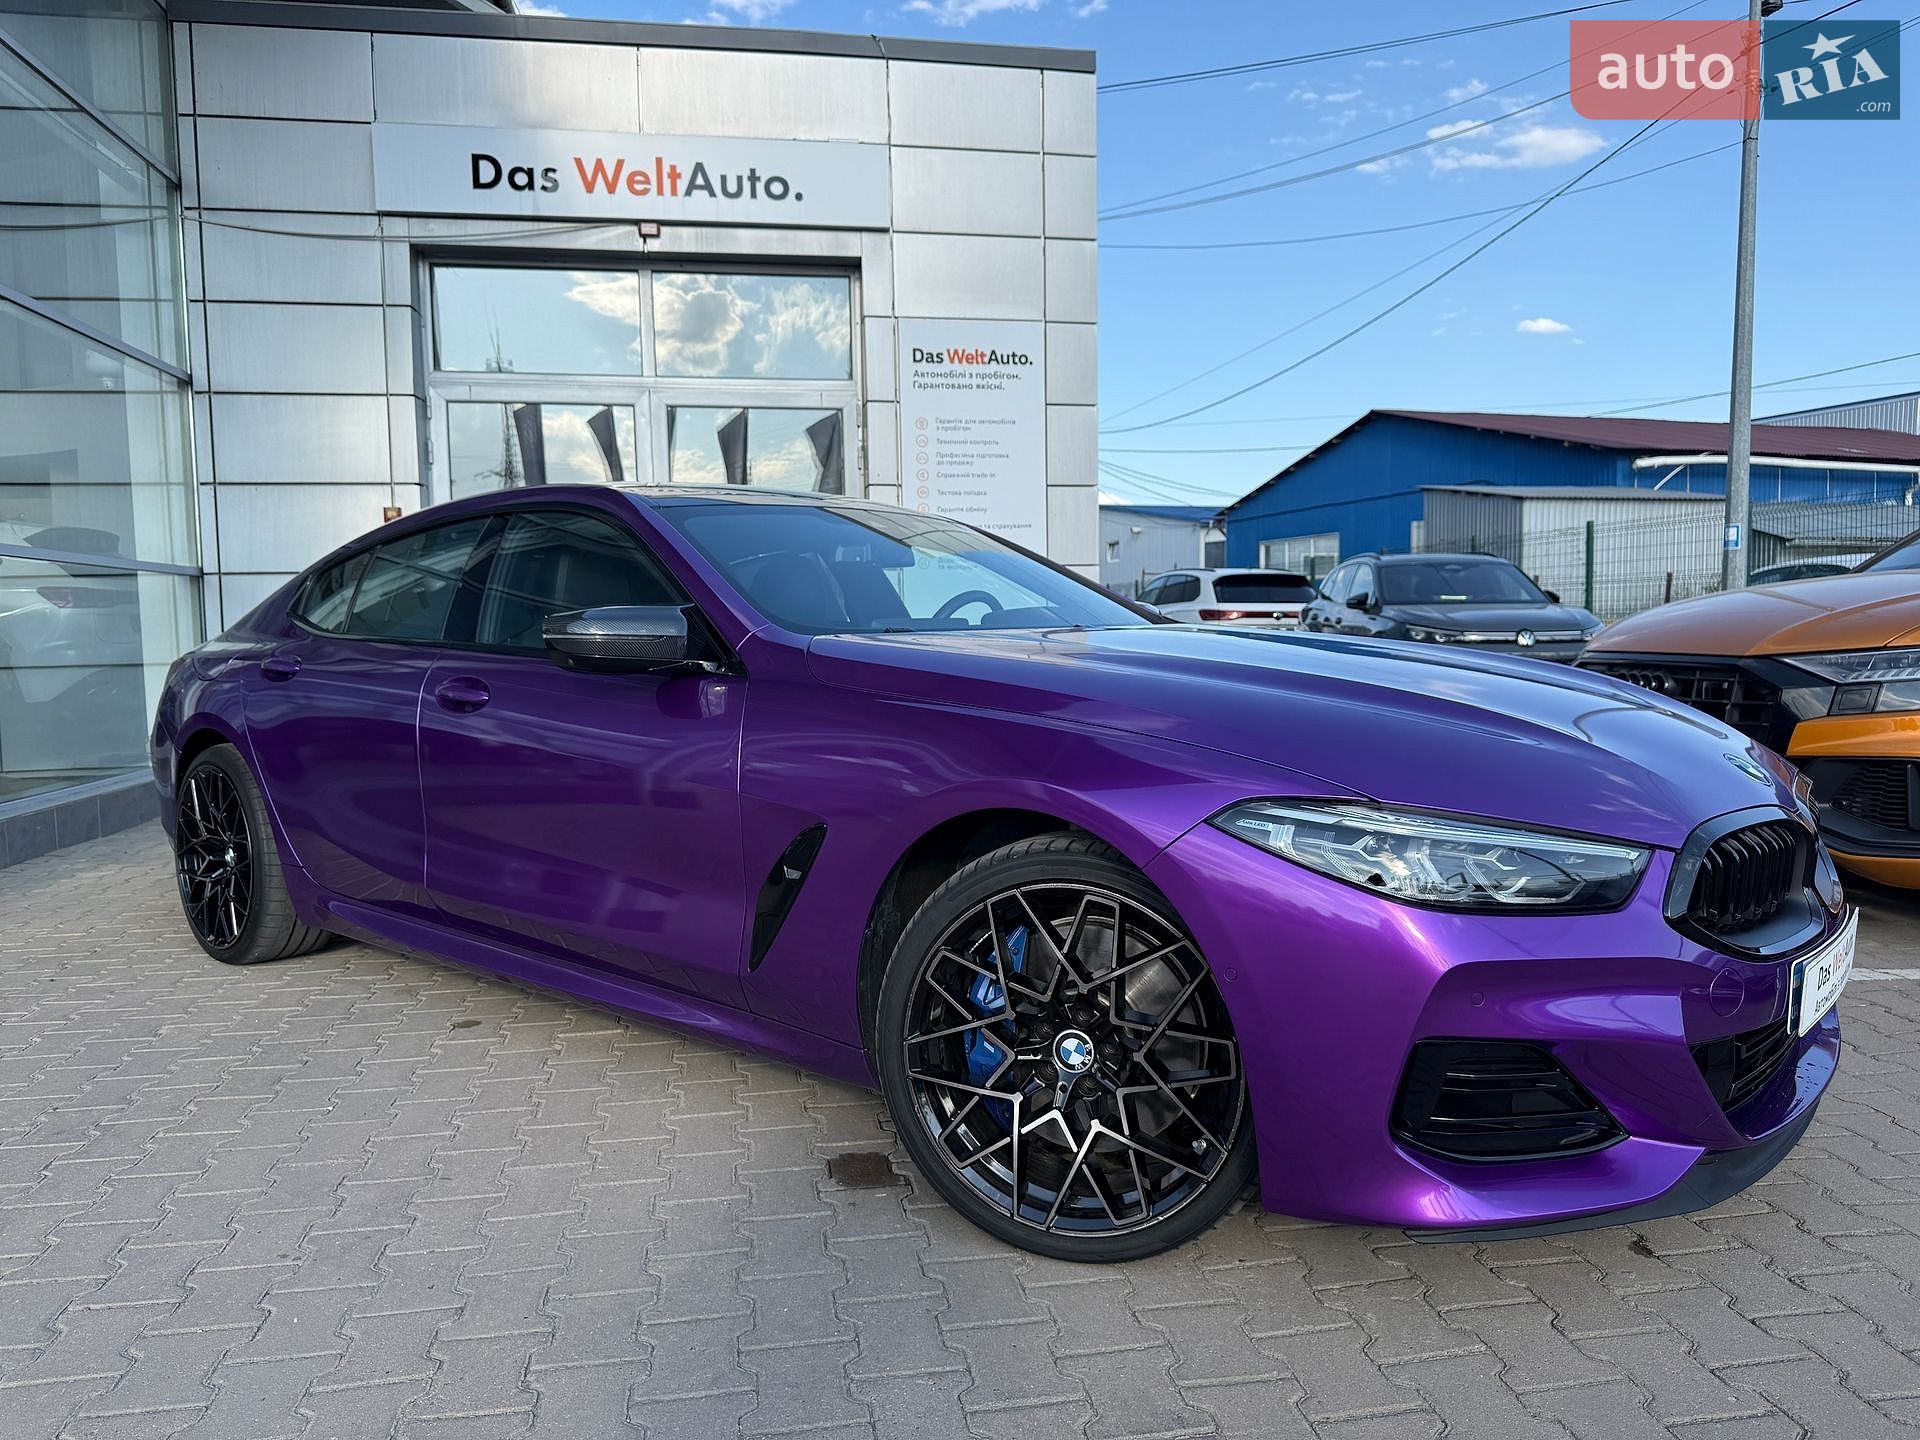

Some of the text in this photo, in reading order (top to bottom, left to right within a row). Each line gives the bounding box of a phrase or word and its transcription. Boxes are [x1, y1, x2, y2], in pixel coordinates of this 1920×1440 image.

[470, 152, 805, 202] Das WeltAuto.
[912, 347, 1034, 366] Das WeltAuto.
[913, 369, 967, 379] Автомобілі
[912, 380, 974, 391] Гарантовано
[1074, 1043, 1092, 1070] BMW
